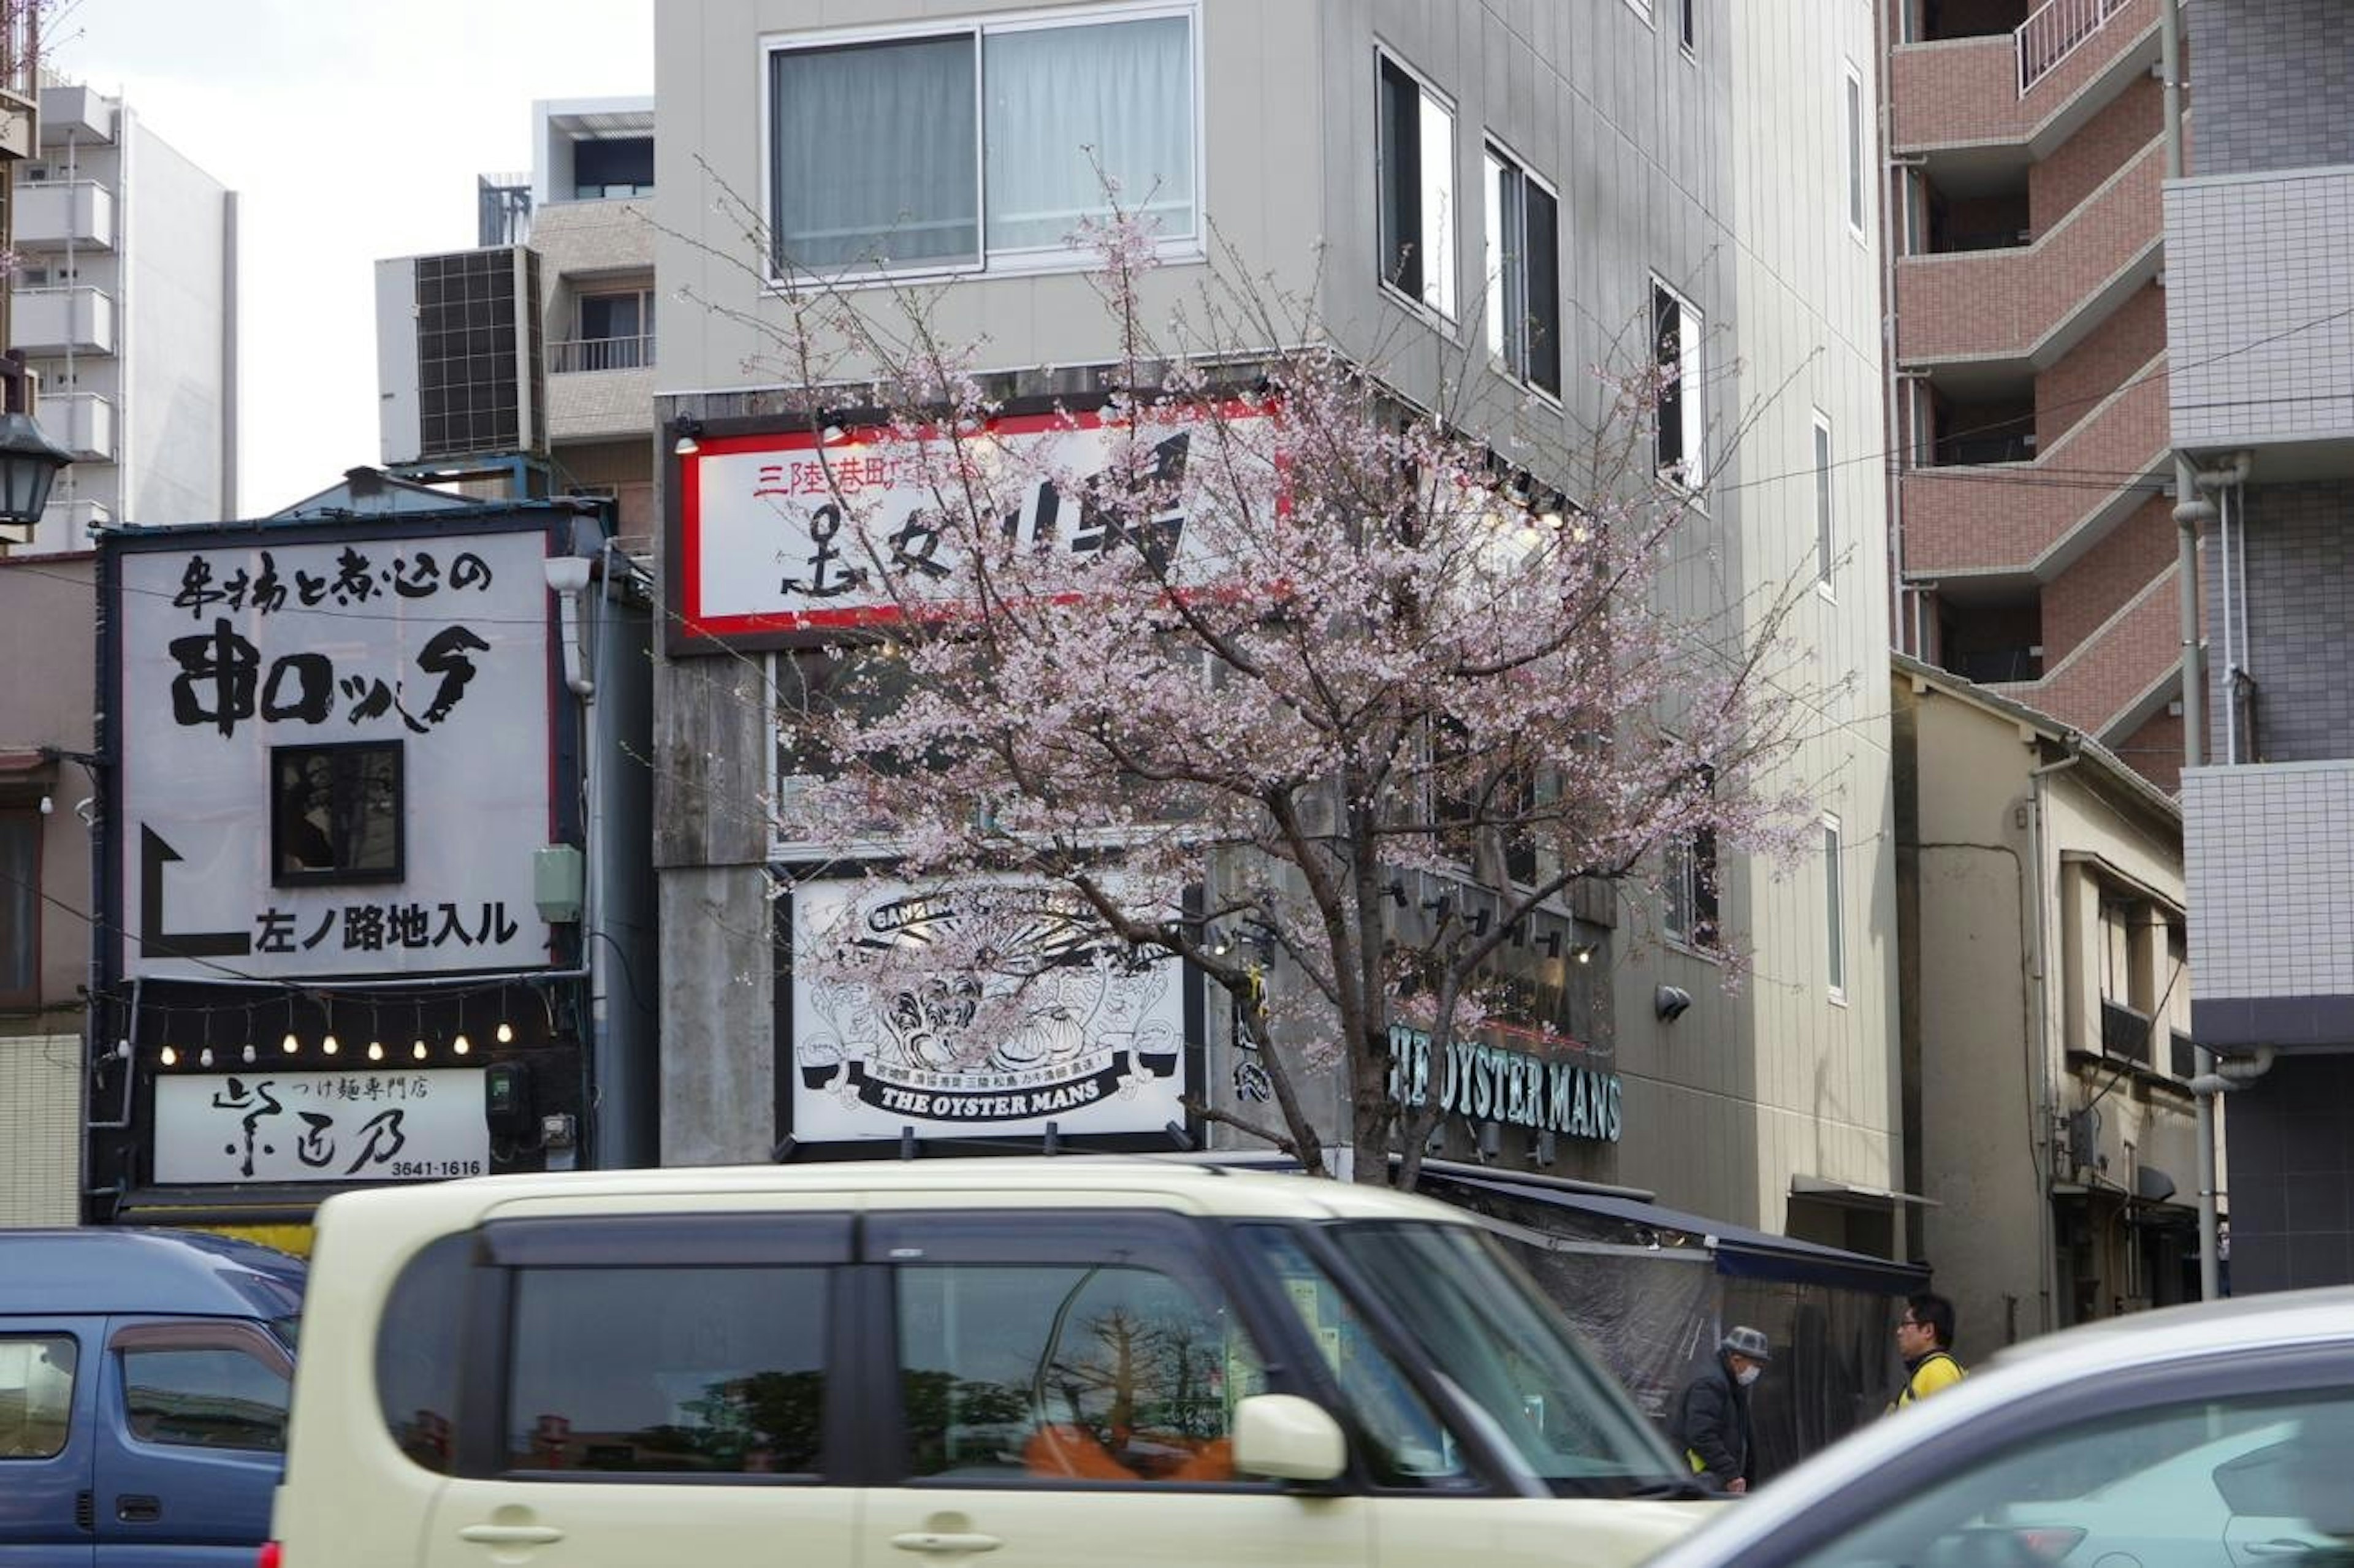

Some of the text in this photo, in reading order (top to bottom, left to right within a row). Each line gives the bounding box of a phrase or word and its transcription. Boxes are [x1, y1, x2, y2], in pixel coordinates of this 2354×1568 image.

[255, 901, 518, 953] 左ノ路地入ル
[292, 1076, 429, 1101] つけ麺専門店
[882, 1080, 1100, 1117] THE OYSTER MANS
[1548, 1061, 1622, 1141] MANS
[392, 1161, 481, 1176] 3641-1616
